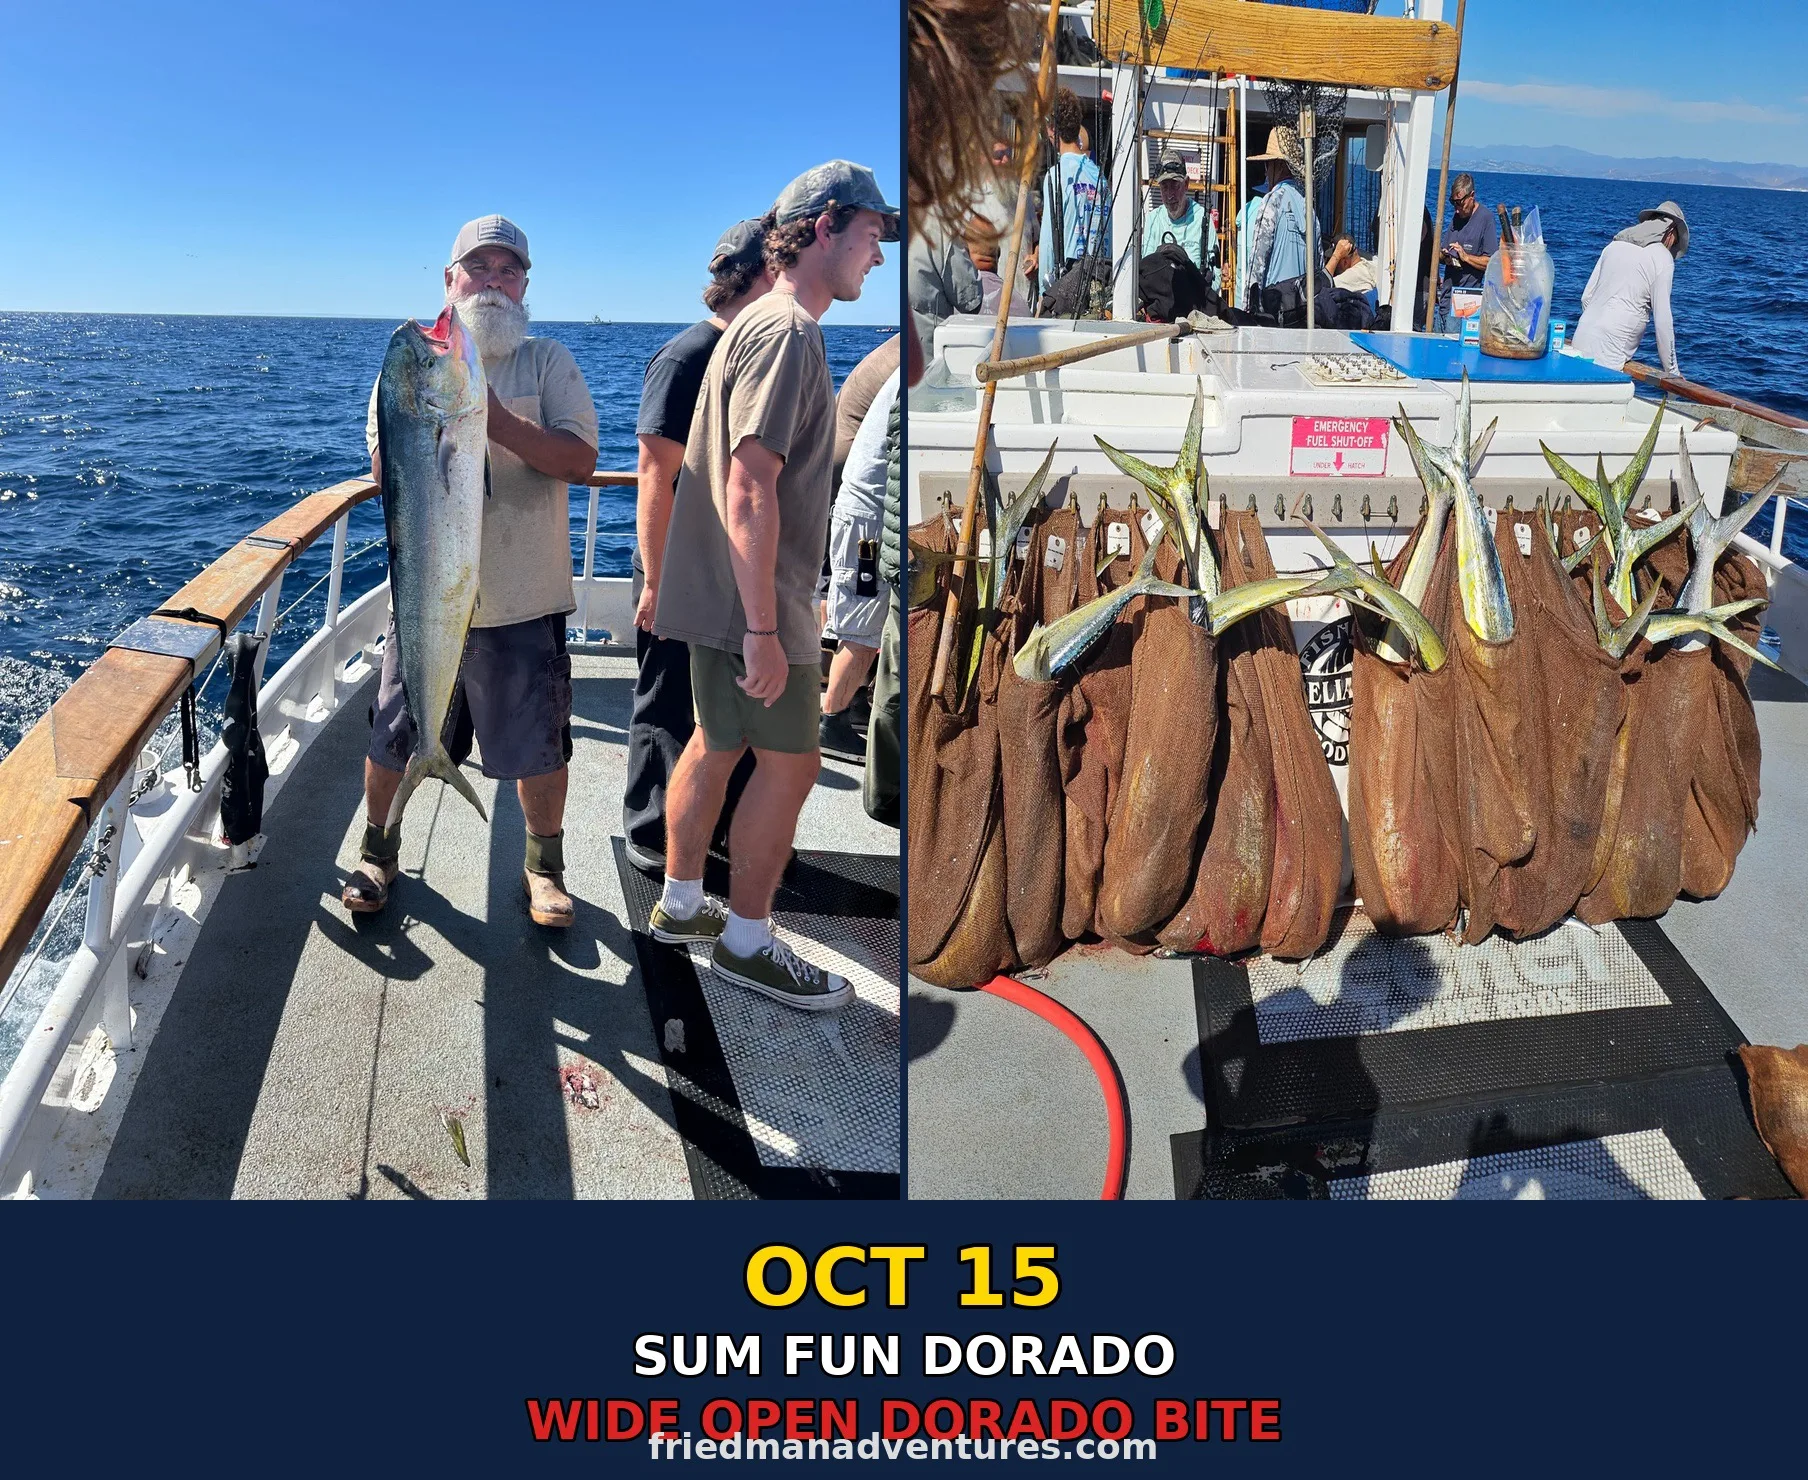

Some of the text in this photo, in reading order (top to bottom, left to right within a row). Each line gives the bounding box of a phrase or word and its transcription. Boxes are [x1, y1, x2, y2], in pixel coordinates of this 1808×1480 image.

[1313, 421, 1369, 433] EMERGENCY
[1306, 435, 1328, 447] FUEL
[1313, 461, 1366, 469] UNDER HATCH
